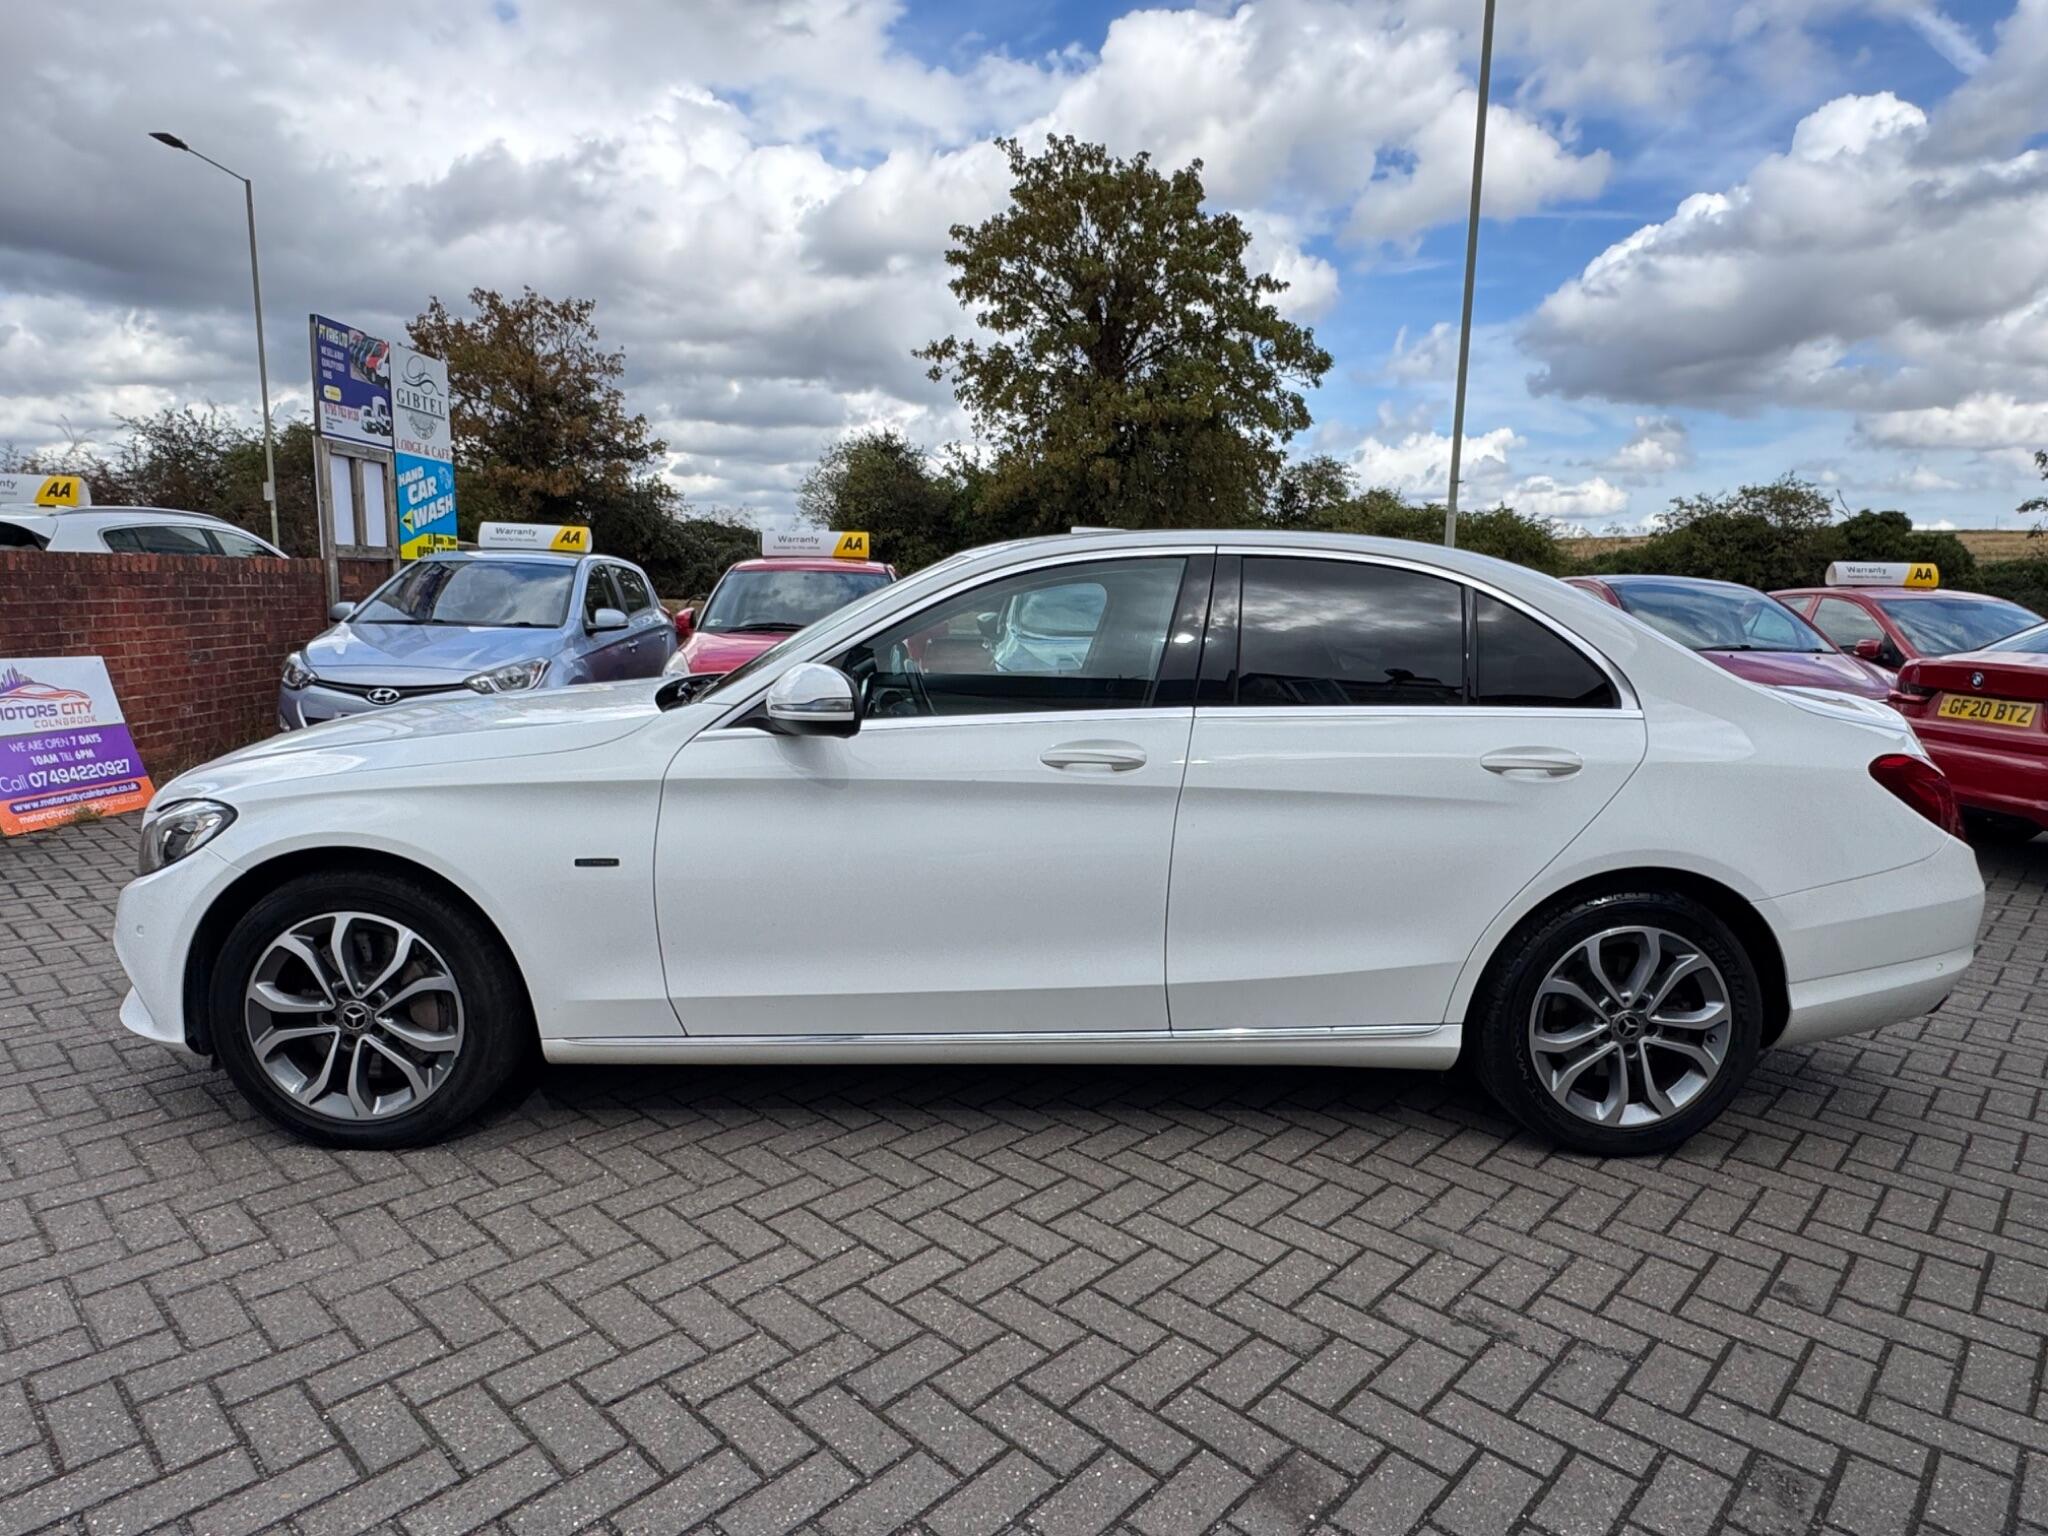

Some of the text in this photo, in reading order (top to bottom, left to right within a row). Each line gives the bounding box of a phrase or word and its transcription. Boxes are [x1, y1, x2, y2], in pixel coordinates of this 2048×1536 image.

[396, 388, 446, 417] GIBTEL
[395, 437, 422, 454] LODGE
[398, 466, 424, 488] HAND
[46, 482, 71, 498] AA
[408, 475, 438, 506] CAR
[413, 493, 453, 529] WASH
[495, 527, 537, 537] Warranty
[560, 530, 581, 544] AA
[777, 535, 820, 545] Warranty
[842, 537, 863, 550] AA
[1846, 565, 1887, 575] Warranty
[1913, 567, 1933, 580] AA
[61, 700, 93, 716] CITY
[1948, 698, 2033, 724] GF20 BTZ
[34, 714, 97, 729] COLNBROOK
[8, 733, 102, 753] WE ARE OPEN 7 DAYS
[30, 748, 96, 766] 10AM TILL 6PM
[0, 758, 131, 793] Call 07494220927
